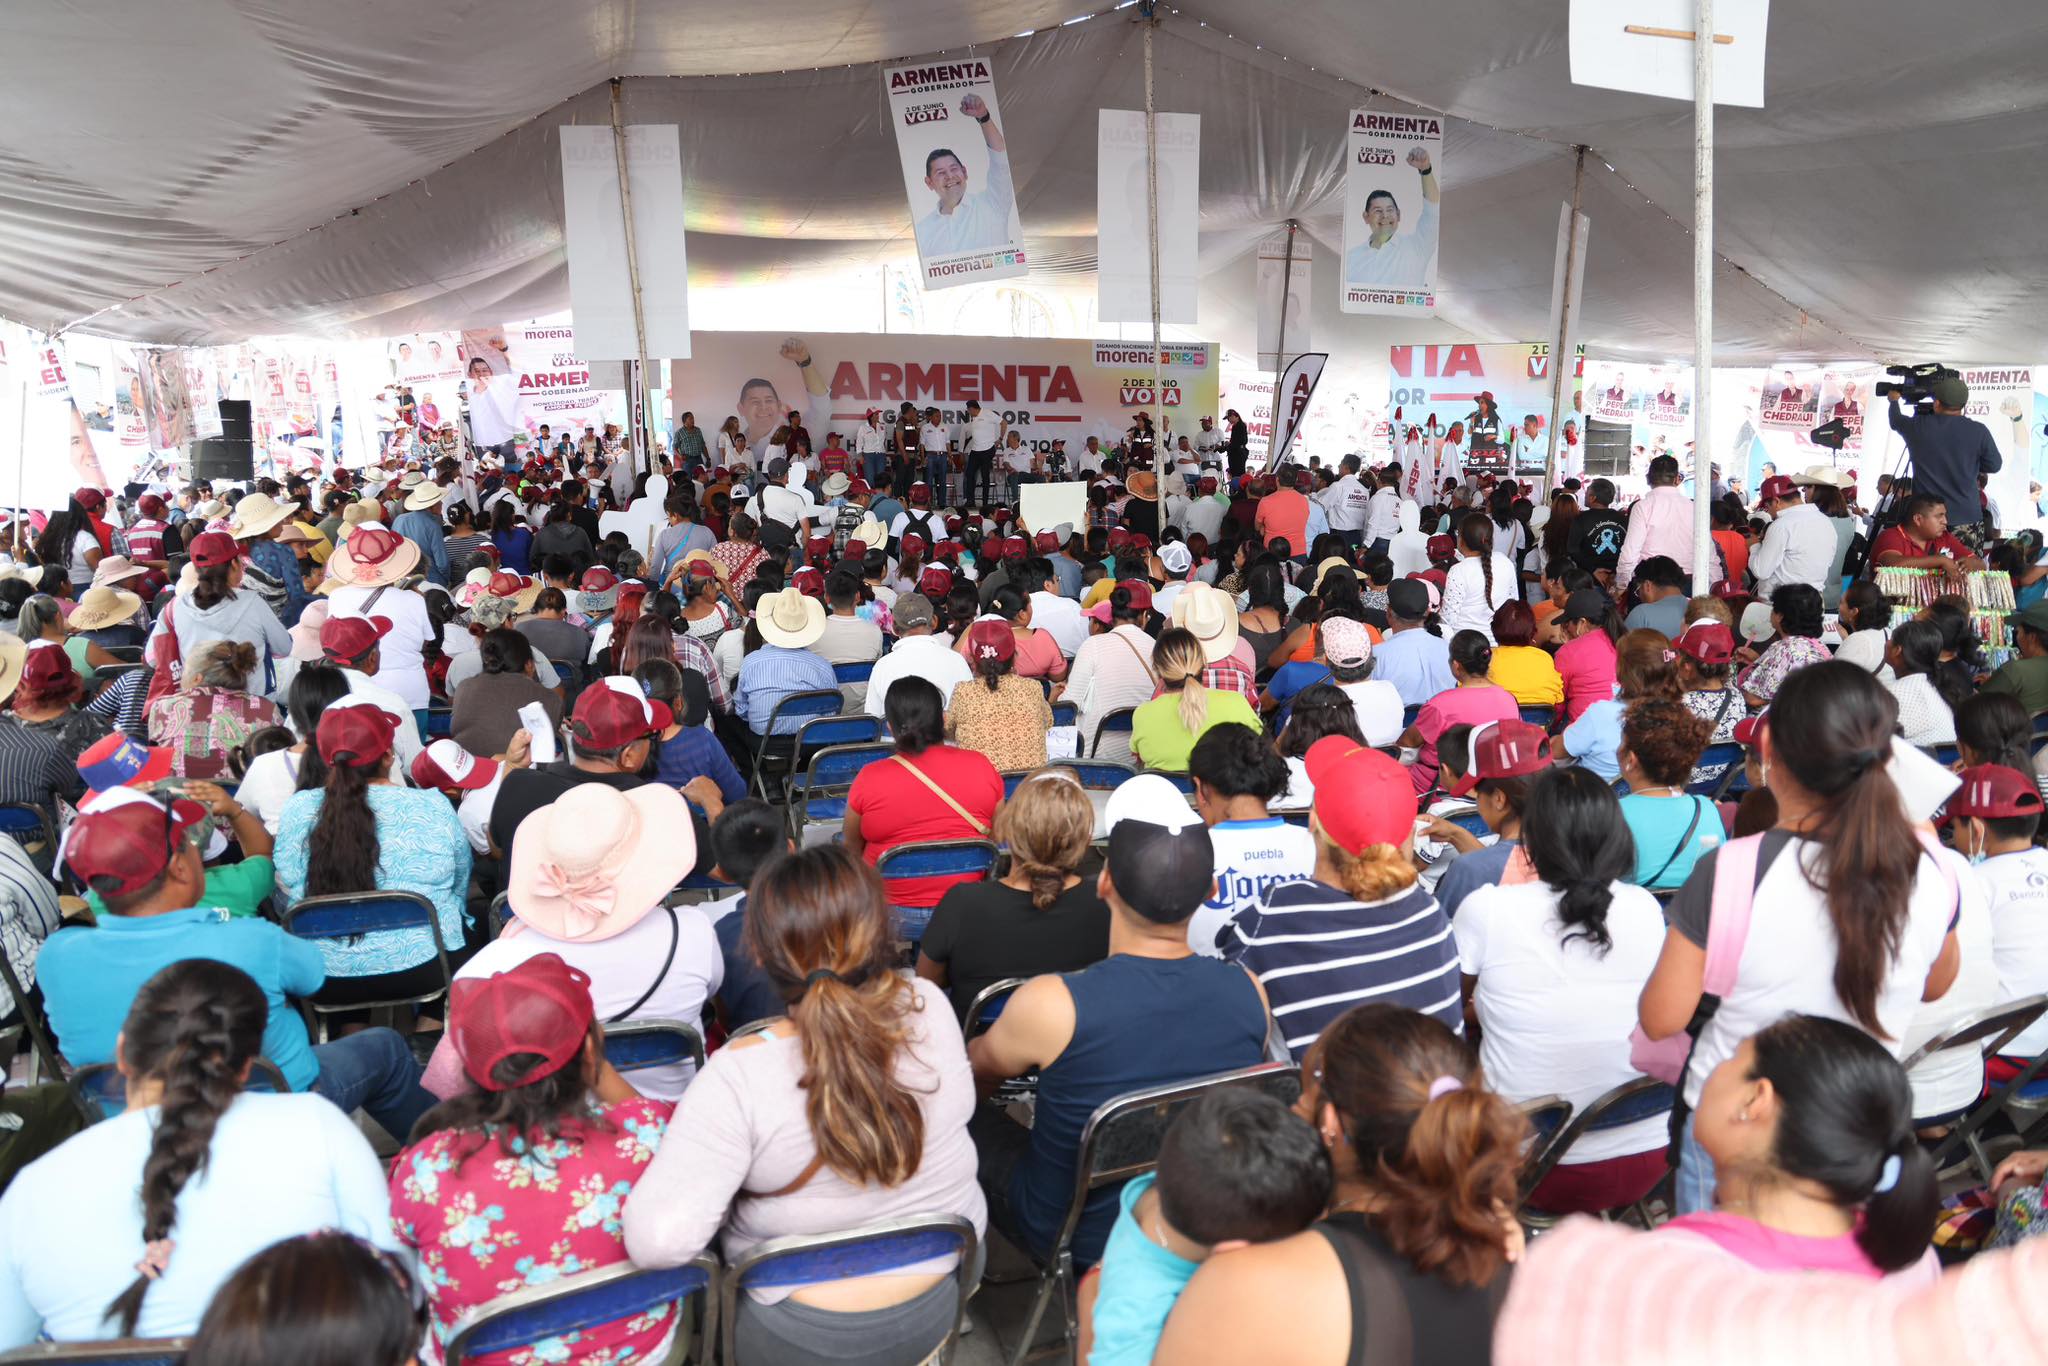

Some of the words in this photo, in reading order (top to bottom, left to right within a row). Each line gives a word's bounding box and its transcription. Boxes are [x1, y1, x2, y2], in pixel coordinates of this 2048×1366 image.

[891, 62, 988, 89] ARMENTA
[910, 80, 974, 94] GOBERNADOR
[923, 102, 944, 110] JUNIO
[906, 108, 947, 124] VOTA
[1353, 114, 1440, 134] ARMENTA
[1368, 131, 1425, 141] GOBERNADOR
[1359, 153, 1394, 165] VOTA
[928, 260, 982, 278] morena
[1348, 292, 1394, 304] morena
[525, 329, 572, 340] morena
[553, 357, 587, 367] VOTA
[518, 371, 589, 389] ARMEN
[829, 362, 1083, 403] ARMENTA
[1122, 379, 1129, 387] 2
[1131, 379, 1145, 387] DE
[1959, 370, 2031, 384] ARMENTA
[541, 386, 590, 396] GOBERNAD
[1239, 383, 1274, 394] morena
[1606, 400, 1626, 409] PEPE
[1658, 406, 1678, 414] PEPE
[1780, 403, 1804, 412] PEPE
[1965, 406, 1989, 415] OTA
[1599, 407, 1634, 418] HEDRAUI
[1649, 413, 1685, 423] CHEDRAUI
[1763, 410, 1813, 422] CHEDRAUI
[1244, 849, 1284, 861] puebla
[1203, 866, 1314, 912] Coron
[2009, 889, 2043, 901] Banco
